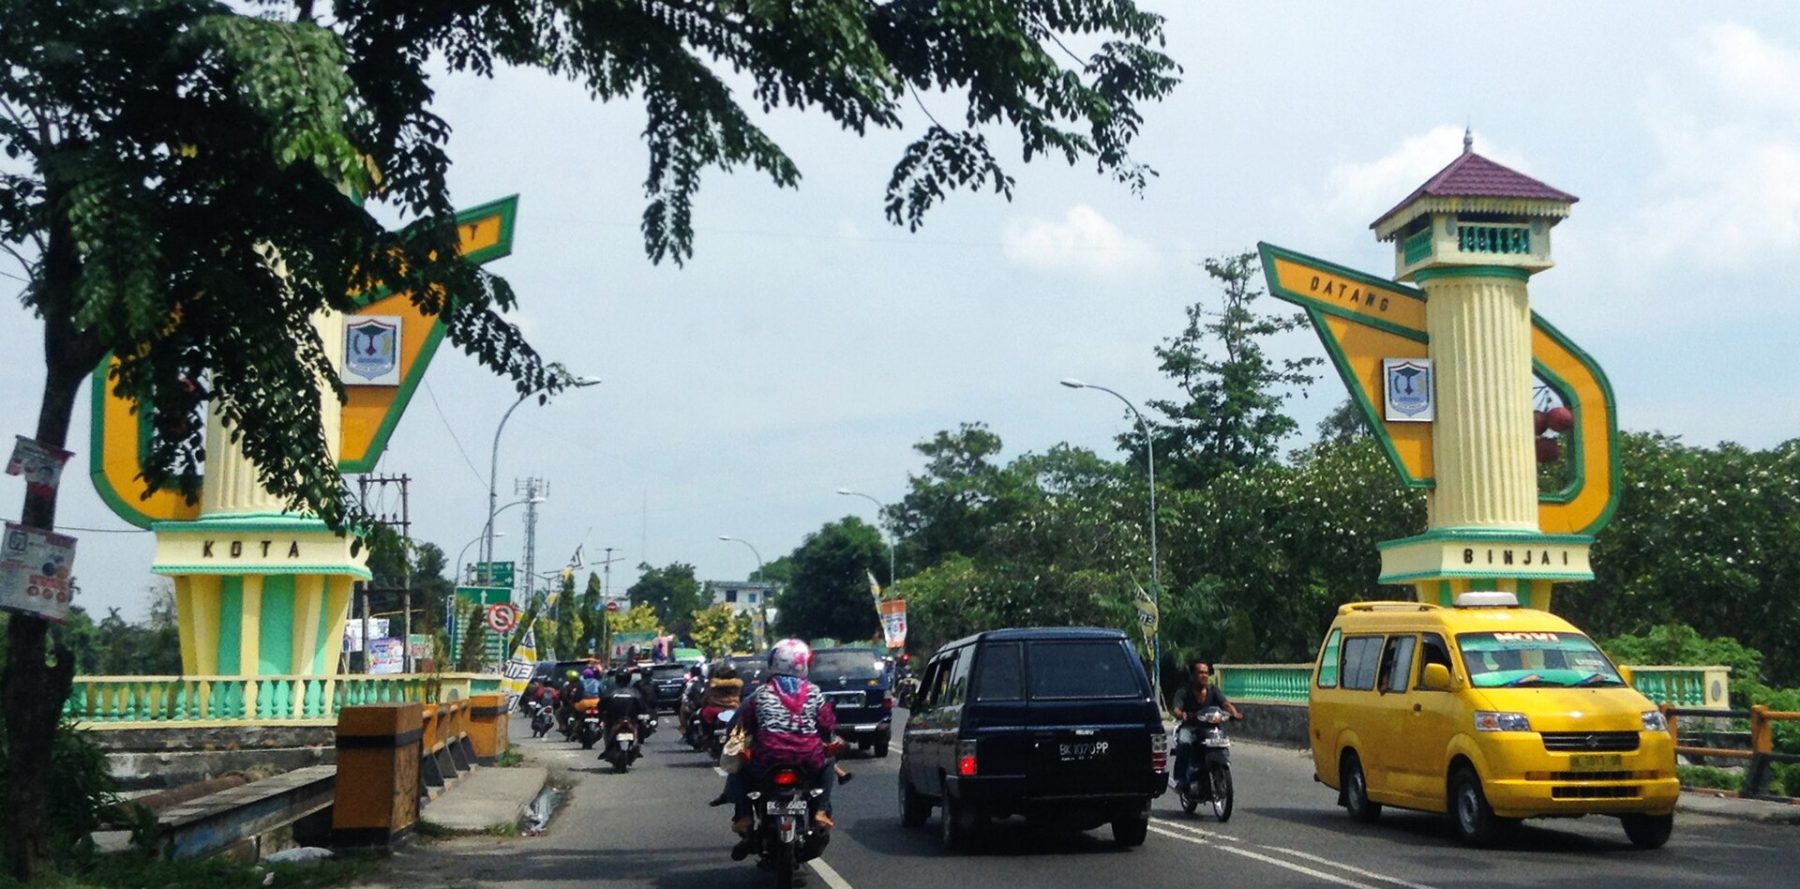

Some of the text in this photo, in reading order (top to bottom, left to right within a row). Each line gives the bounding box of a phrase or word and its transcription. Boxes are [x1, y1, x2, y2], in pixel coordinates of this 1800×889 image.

[1310, 275, 1389, 312] DATANG
[203, 540, 299, 558] KOTA
[1463, 549, 1568, 566] BINJAI
